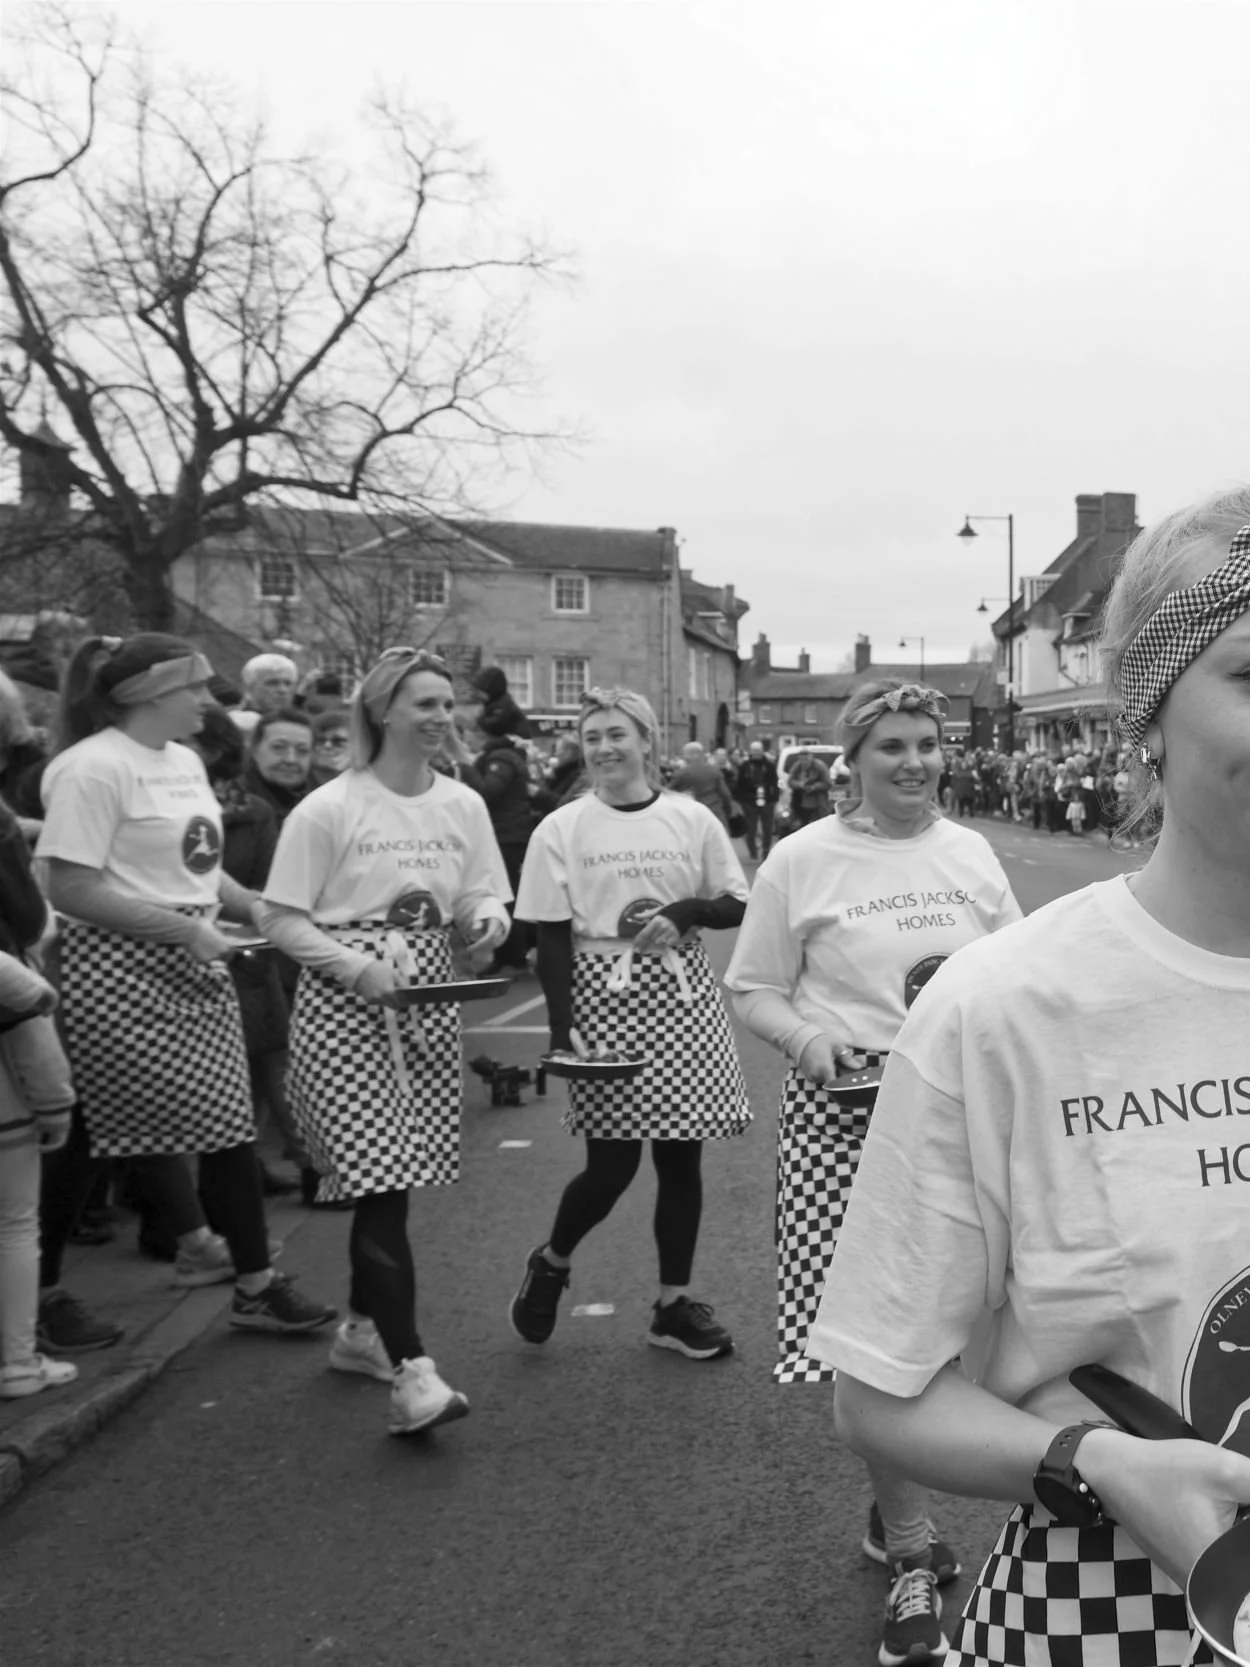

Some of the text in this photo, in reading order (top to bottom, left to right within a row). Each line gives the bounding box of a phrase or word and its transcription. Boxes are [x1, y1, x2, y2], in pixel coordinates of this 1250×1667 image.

[639, 850, 690, 863] JACKSO
[846, 893, 918, 920] FRANCIS
[896, 913, 956, 931] HOMES
